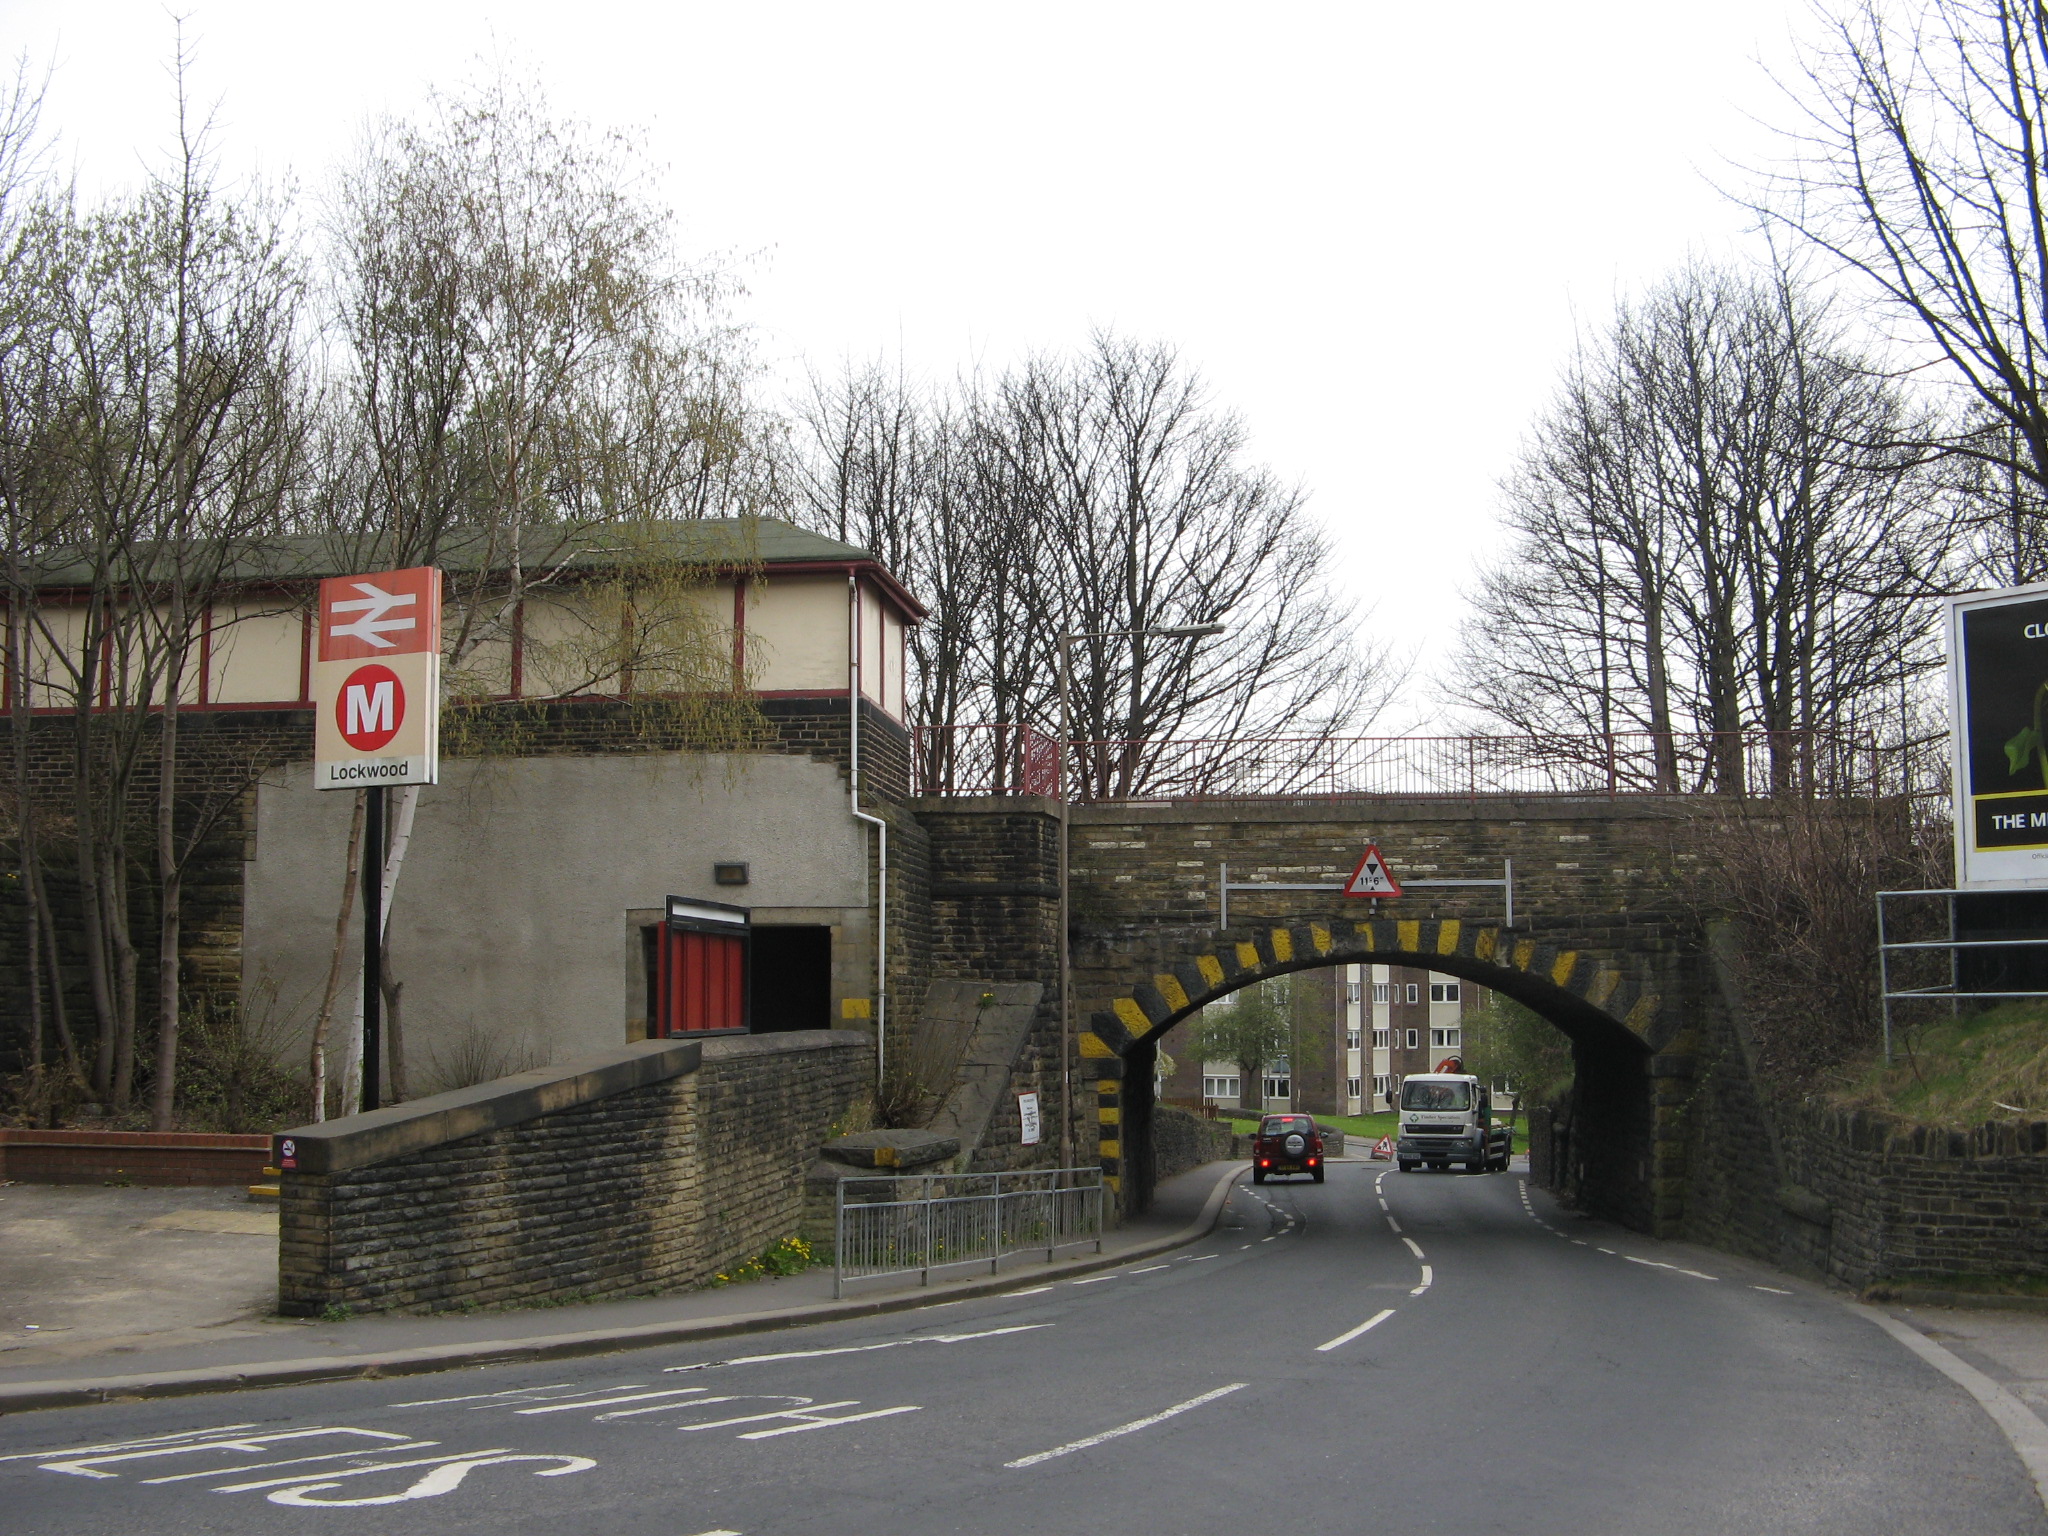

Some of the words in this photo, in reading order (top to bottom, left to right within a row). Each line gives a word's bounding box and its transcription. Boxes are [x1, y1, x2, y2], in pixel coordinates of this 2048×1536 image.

[346, 681, 394, 735] M
[331, 761, 408, 780] Lockwood
[1991, 813, 2026, 830] THE
[2030, 812, 2048, 828] M
